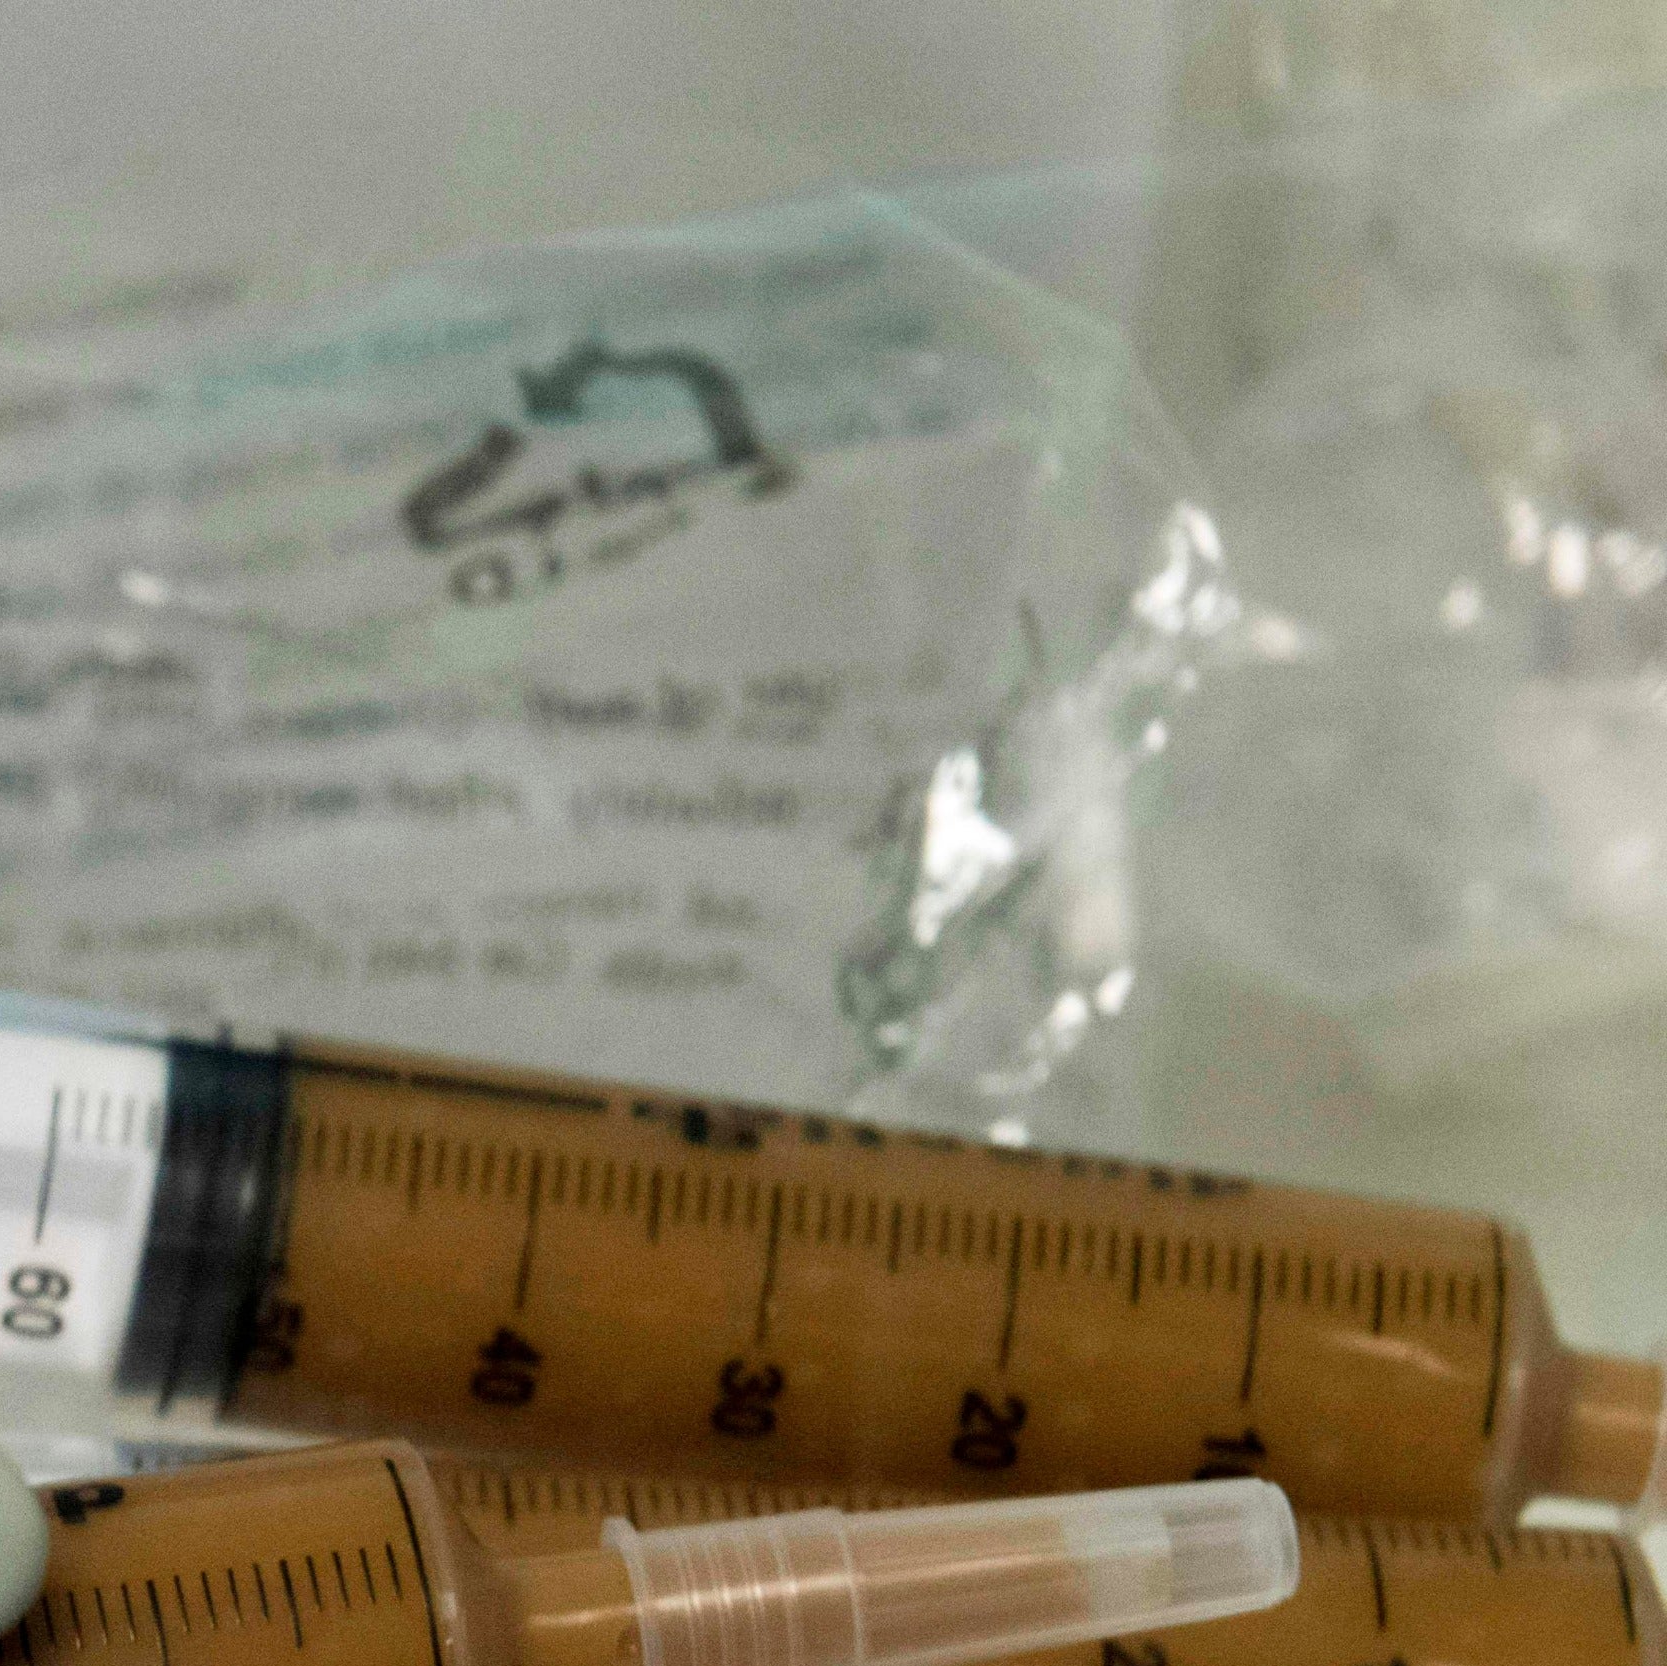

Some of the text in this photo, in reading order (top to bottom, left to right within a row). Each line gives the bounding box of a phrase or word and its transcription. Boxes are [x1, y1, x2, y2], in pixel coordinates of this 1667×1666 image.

[2, 1263, 72, 1340] 60
[470, 1326, 542, 1405] 40
[710, 1357, 786, 1440] 30
[950, 1388, 1029, 1470] 20
